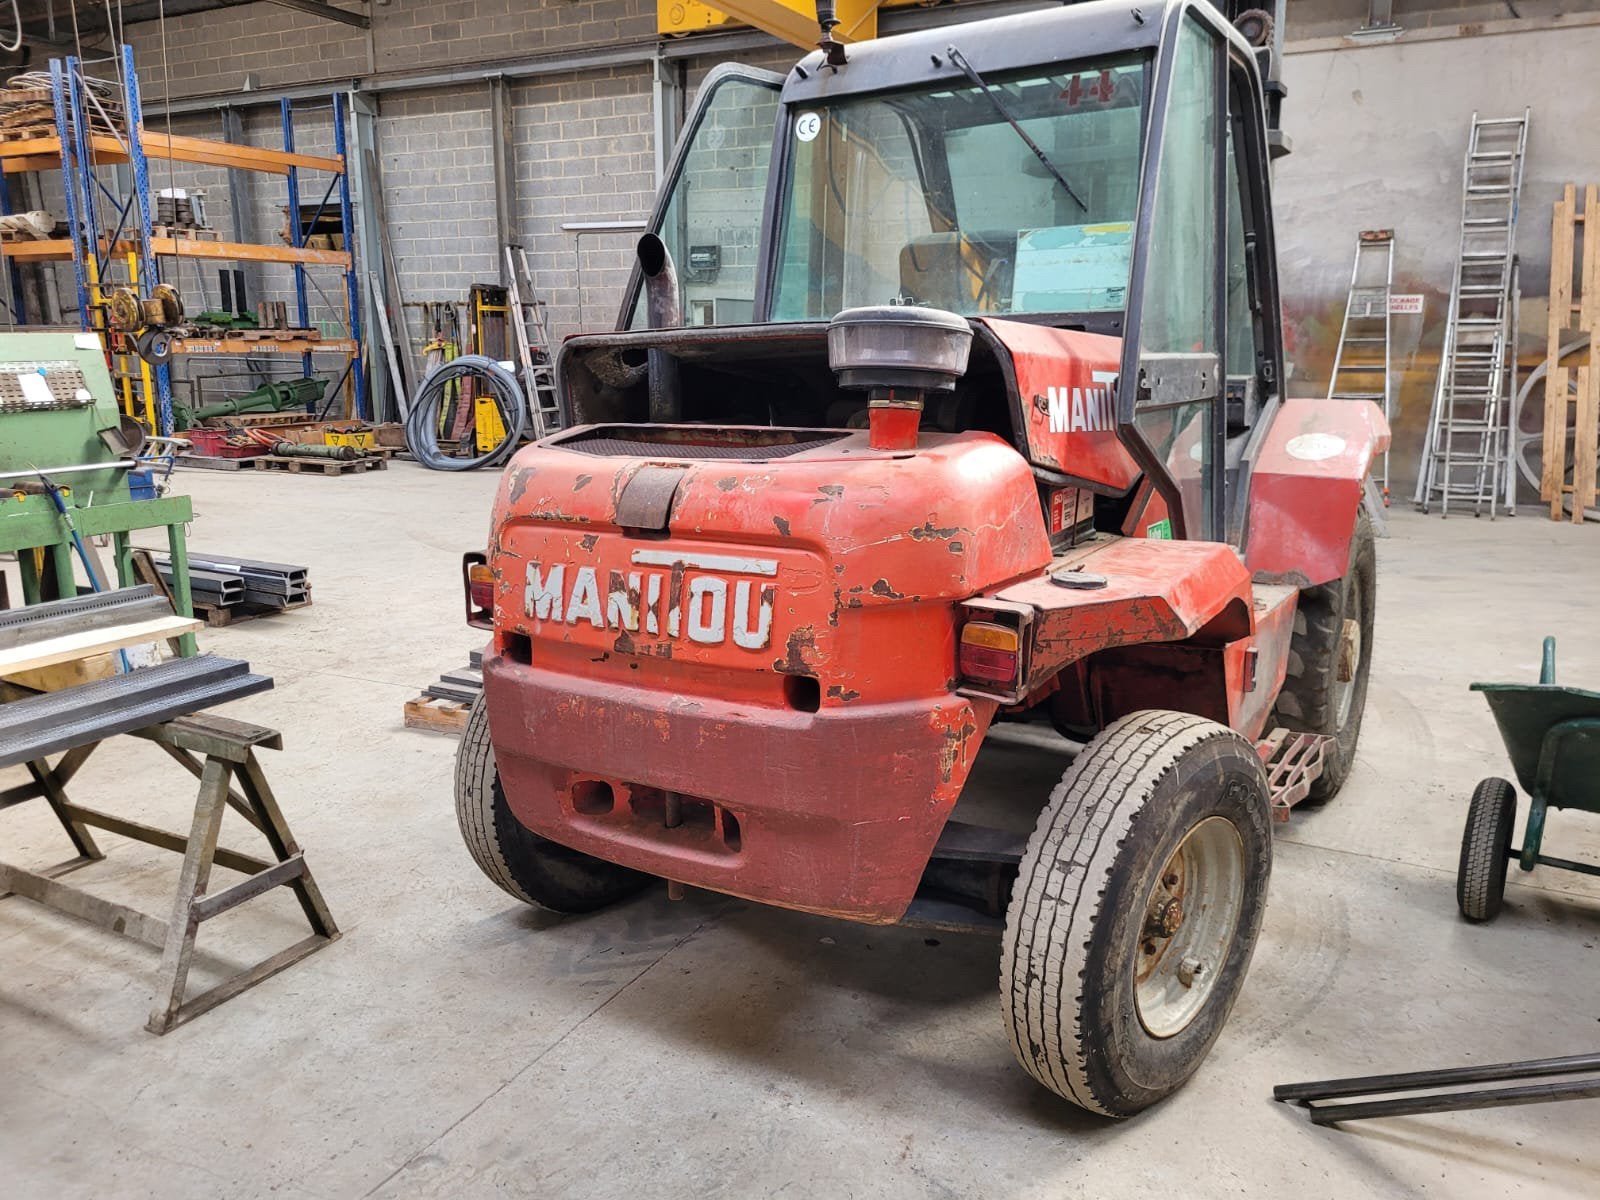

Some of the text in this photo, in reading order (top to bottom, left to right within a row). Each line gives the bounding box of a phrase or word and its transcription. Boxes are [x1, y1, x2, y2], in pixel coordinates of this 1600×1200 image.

[799, 118, 817, 134] CE
[1047, 371, 1119, 433] MANIT
[524, 549, 779, 649] MANITOU
